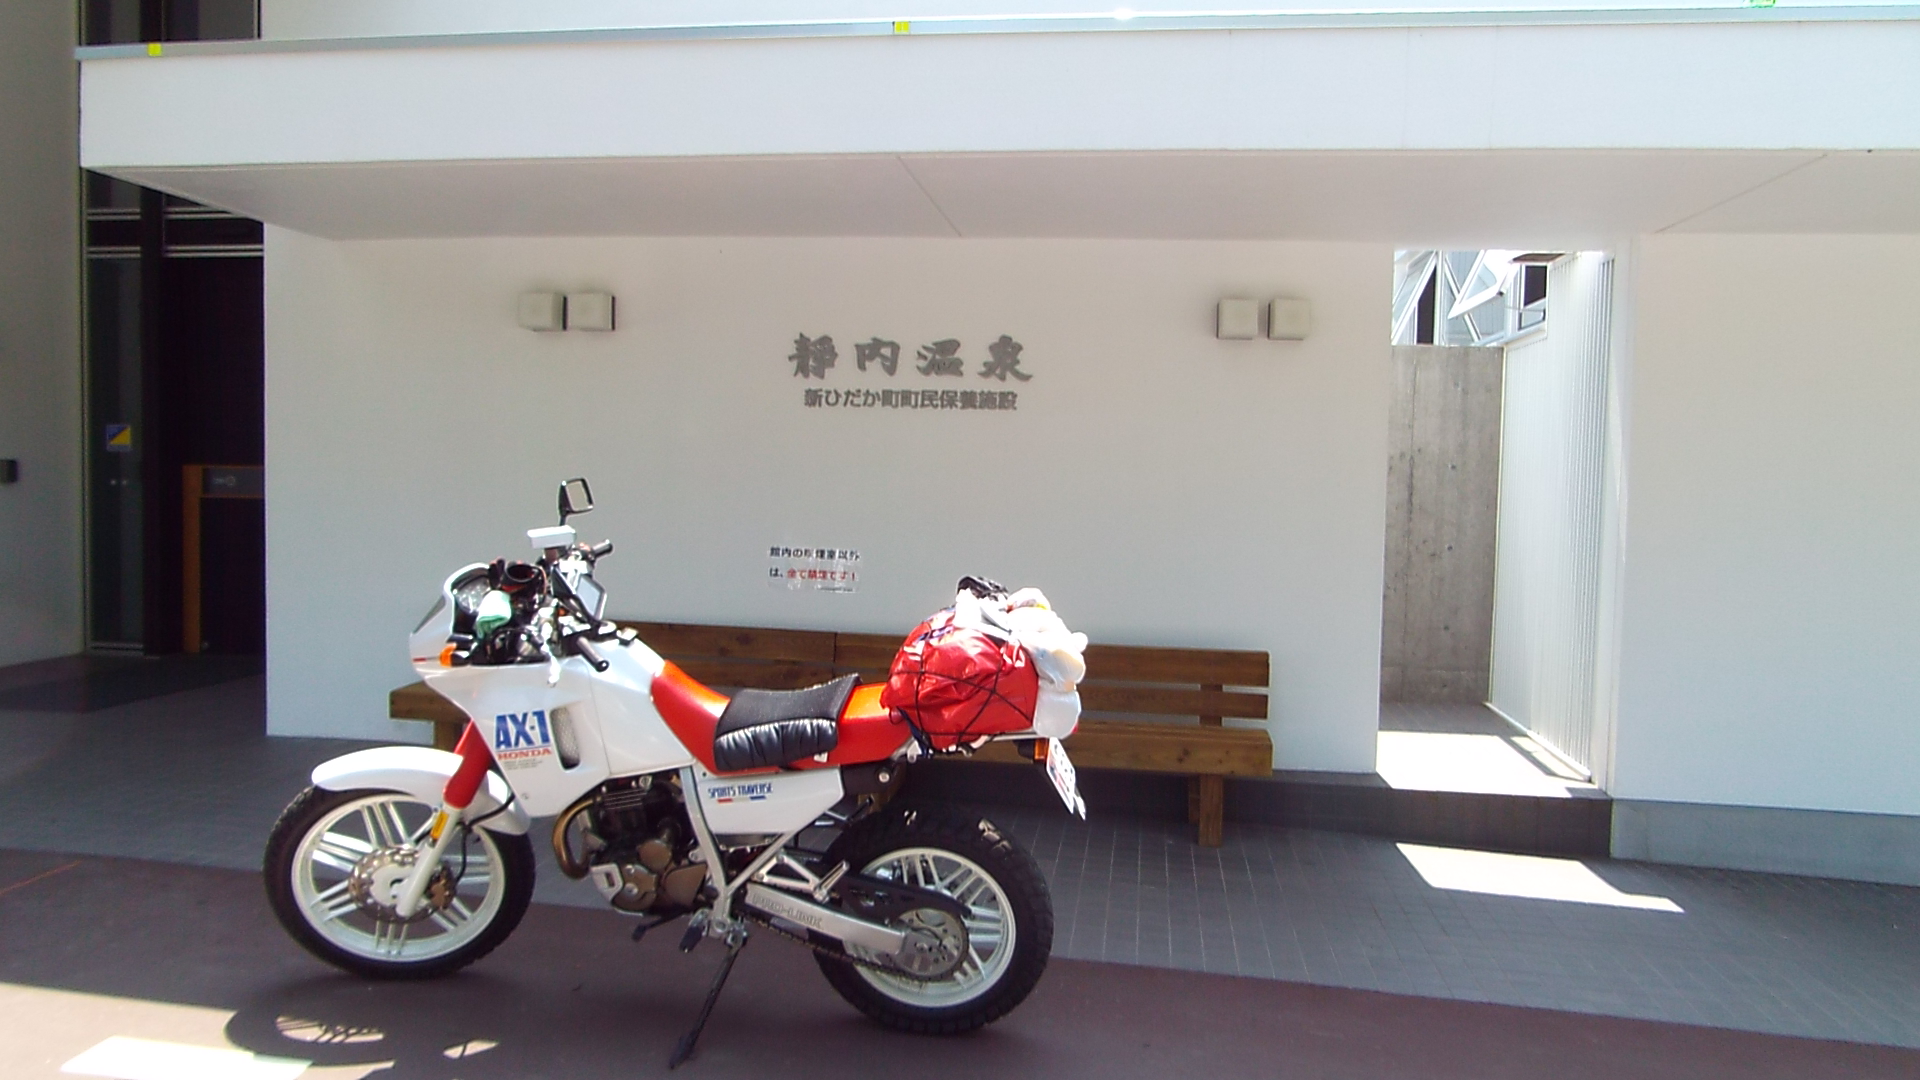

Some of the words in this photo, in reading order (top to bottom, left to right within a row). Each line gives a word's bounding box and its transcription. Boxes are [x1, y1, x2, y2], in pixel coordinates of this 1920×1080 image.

[804, 388, 1018, 410] 新ひだか町町民保養施設
[498, 748, 551, 760] HONDA
[708, 785, 736, 798] SPORTS
[738, 782, 773, 795] TRAVERSE
[752, 893, 823, 928] PRO-LINK
